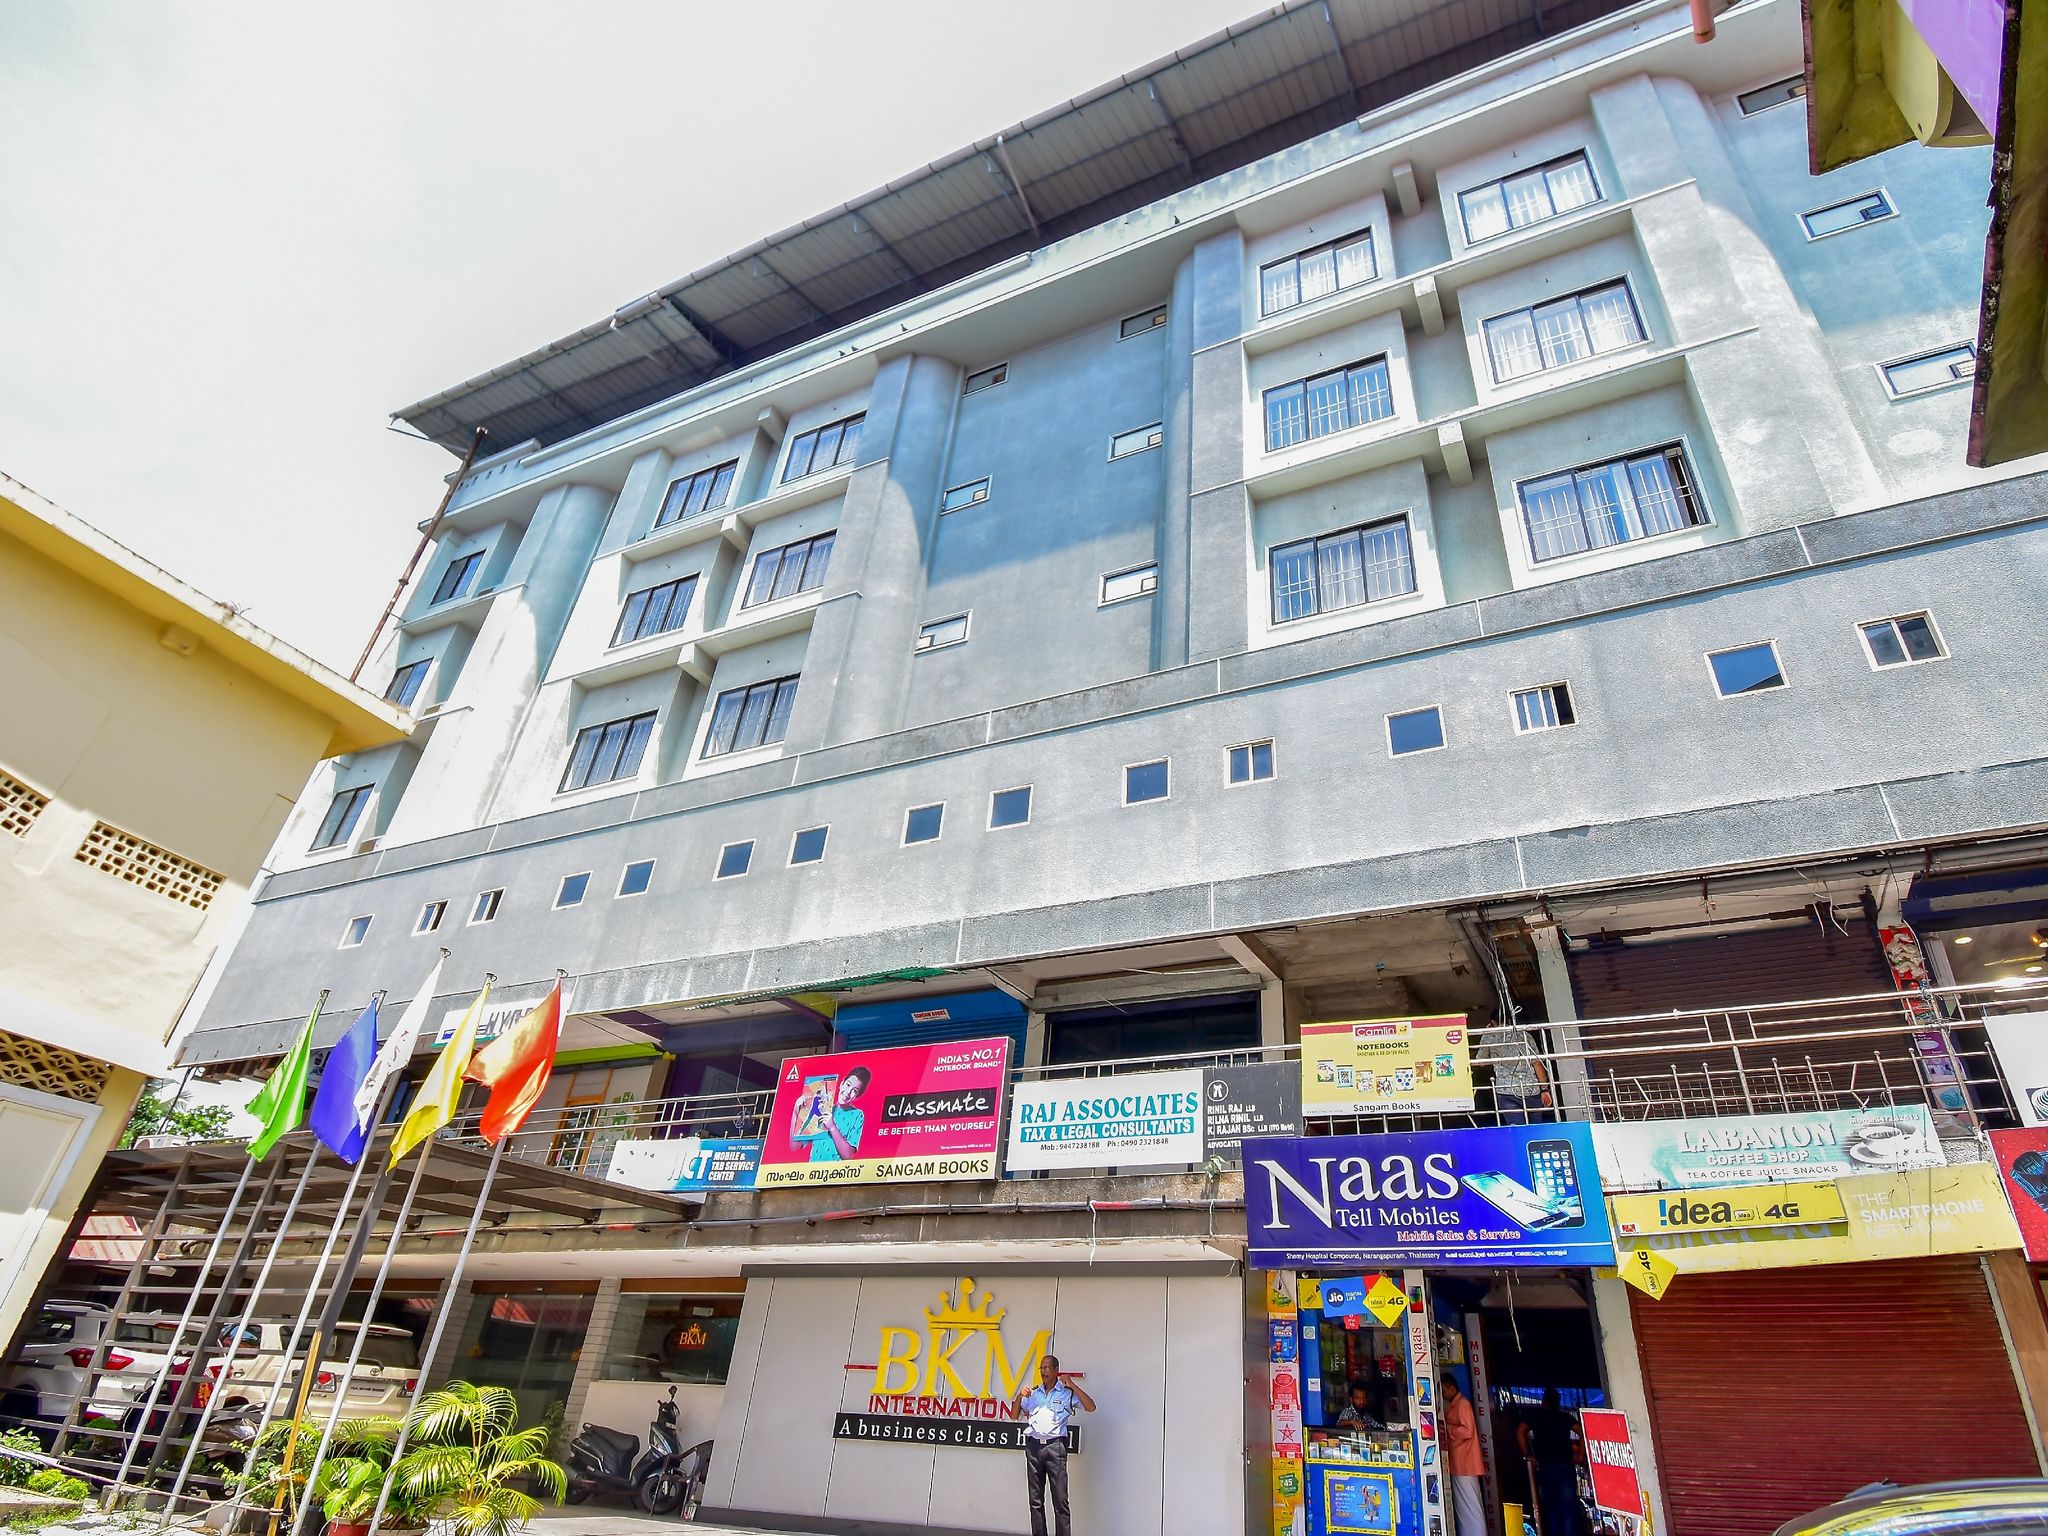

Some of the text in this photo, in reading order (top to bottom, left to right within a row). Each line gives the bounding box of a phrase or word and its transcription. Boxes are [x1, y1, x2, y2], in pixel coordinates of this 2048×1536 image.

[1356, 1027, 1396, 1037] Camlin
[1356, 1042, 1409, 1051] NOTEBOOKS
[937, 1048, 1001, 1064] INDIA'S NO.1
[933, 1064, 971, 1072] NOTEBOOK
[1020, 1091, 1199, 1124] RAJ ASSOCIATES
[1207, 1105, 1227, 1114] RINIL
[1228, 1104, 1243, 1113] RAJ
[1353, 1103, 1389, 1113] Sangam
[1392, 1102, 1421, 1111] Books
[878, 1121, 995, 1136] BE BETTER THAN YOURSELF
[1024, 1118, 1192, 1141] TAX & LEGAL CONSULTANTS
[1678, 1122, 1838, 1153] LABANON
[713, 1151, 746, 1161] MOBILE &
[1708, 1150, 1810, 1166] COFFEE SHOP
[724, 1161, 755, 1171] SERVICE
[876, 1159, 989, 1177] SANGAM BOOKS
[1687, 1165, 1838, 1179] TEA COFFEE JUICE SNACKS
[708, 1171, 735, 1181] CENTER
[1253, 1153, 1460, 1229] Naas
[1857, 1191, 1890, 1207] THE
[1335, 1206, 1460, 1227] Tell Mobiles
[1764, 1203, 1800, 1219] 4G
[1861, 1199, 1984, 1222] SMARTPHONE
[1397, 1229, 1521, 1242] Mobile Sales & Service
[1305, 1252, 1328, 1260] Hospital
[1329, 1252, 1361, 1260] Compound,
[1408, 1251, 1440, 1260] Thalassery
[1637, 1251, 1651, 1270] 4G
[1328, 1292, 1344, 1303] Jio
[1387, 1297, 1404, 1306] 4G
[679, 1332, 707, 1345] BKM
[1412, 1327, 1429, 1368] Naas
[870, 1326, 1053, 1400] BKM
[1470, 1341, 1485, 1416] MOBILE
[839, 1421, 851, 1435] A
[858, 1418, 947, 1442] business
[954, 1425, 1008, 1445] class
[1589, 1439, 1635, 1469] NO PARKING
